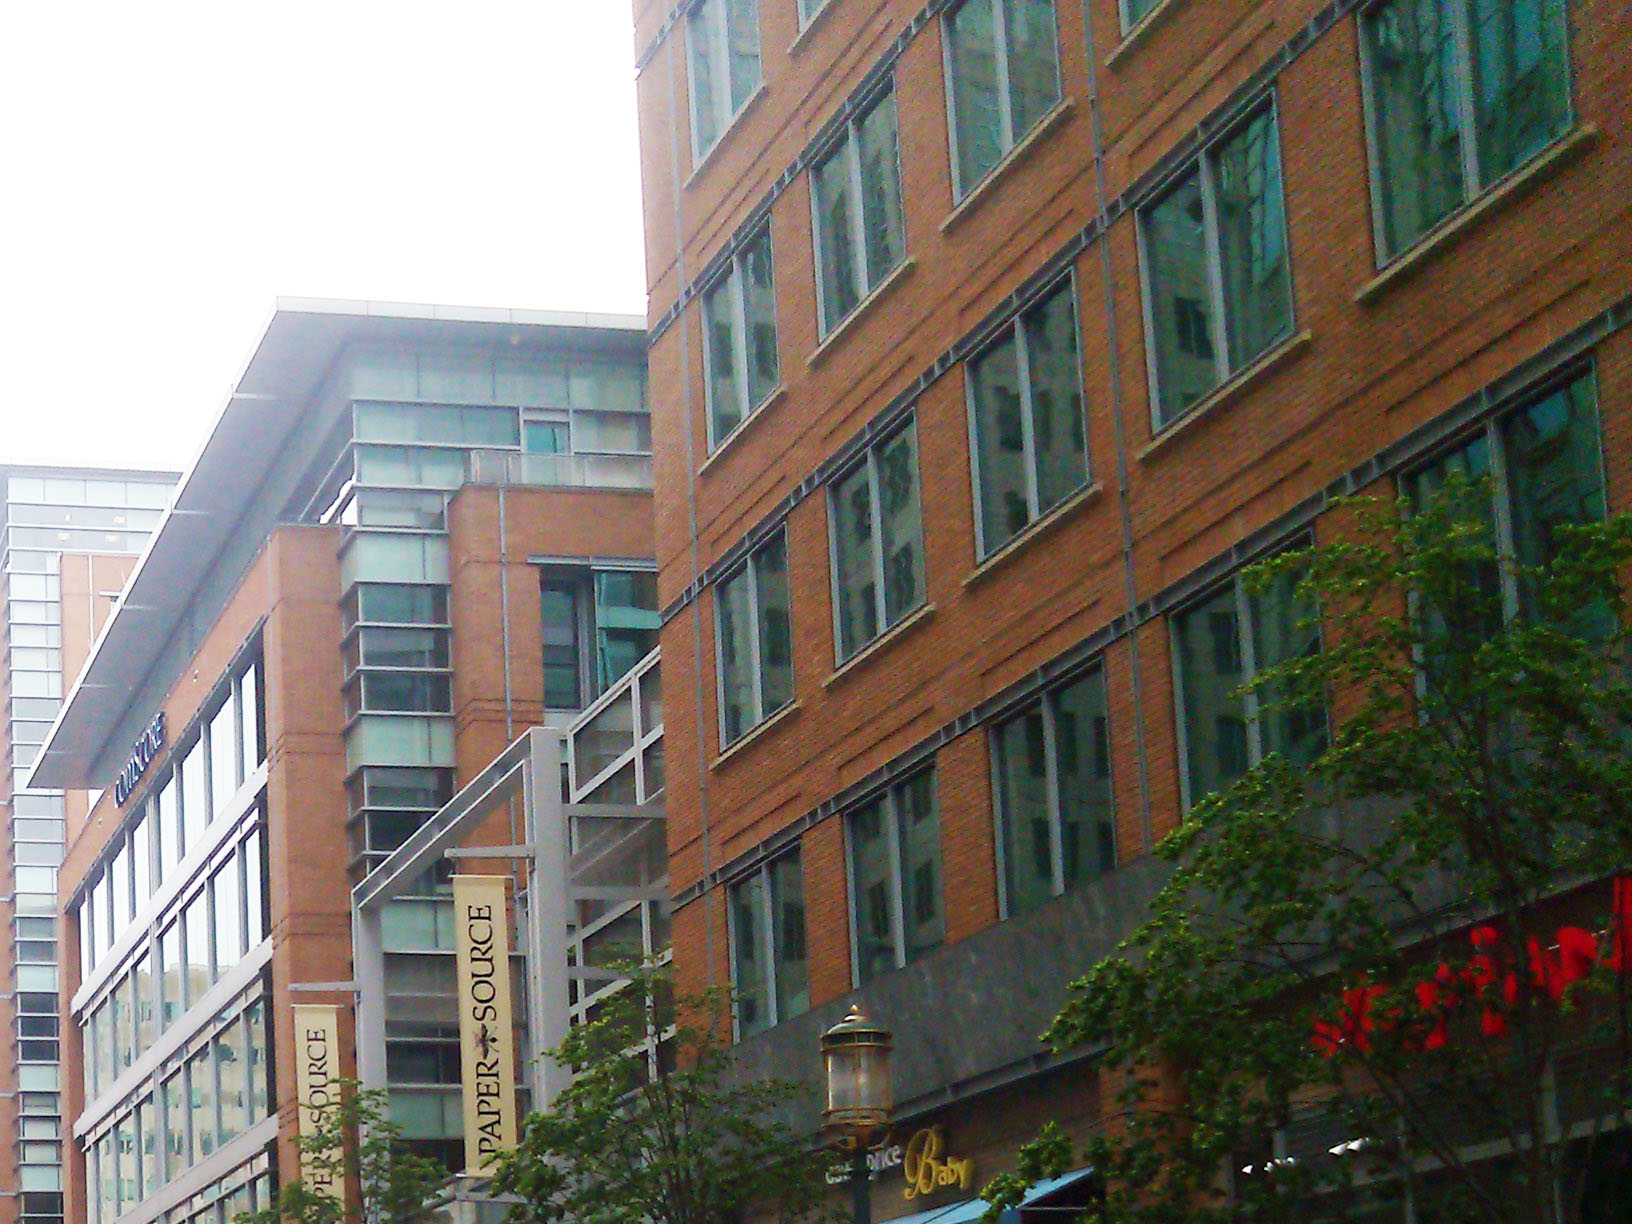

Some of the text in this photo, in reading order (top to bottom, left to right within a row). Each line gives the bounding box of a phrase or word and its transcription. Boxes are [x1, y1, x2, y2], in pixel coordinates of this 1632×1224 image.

[468, 905, 502, 1156] PAPER SOURCE
[904, 1128, 971, 1199] Baby
